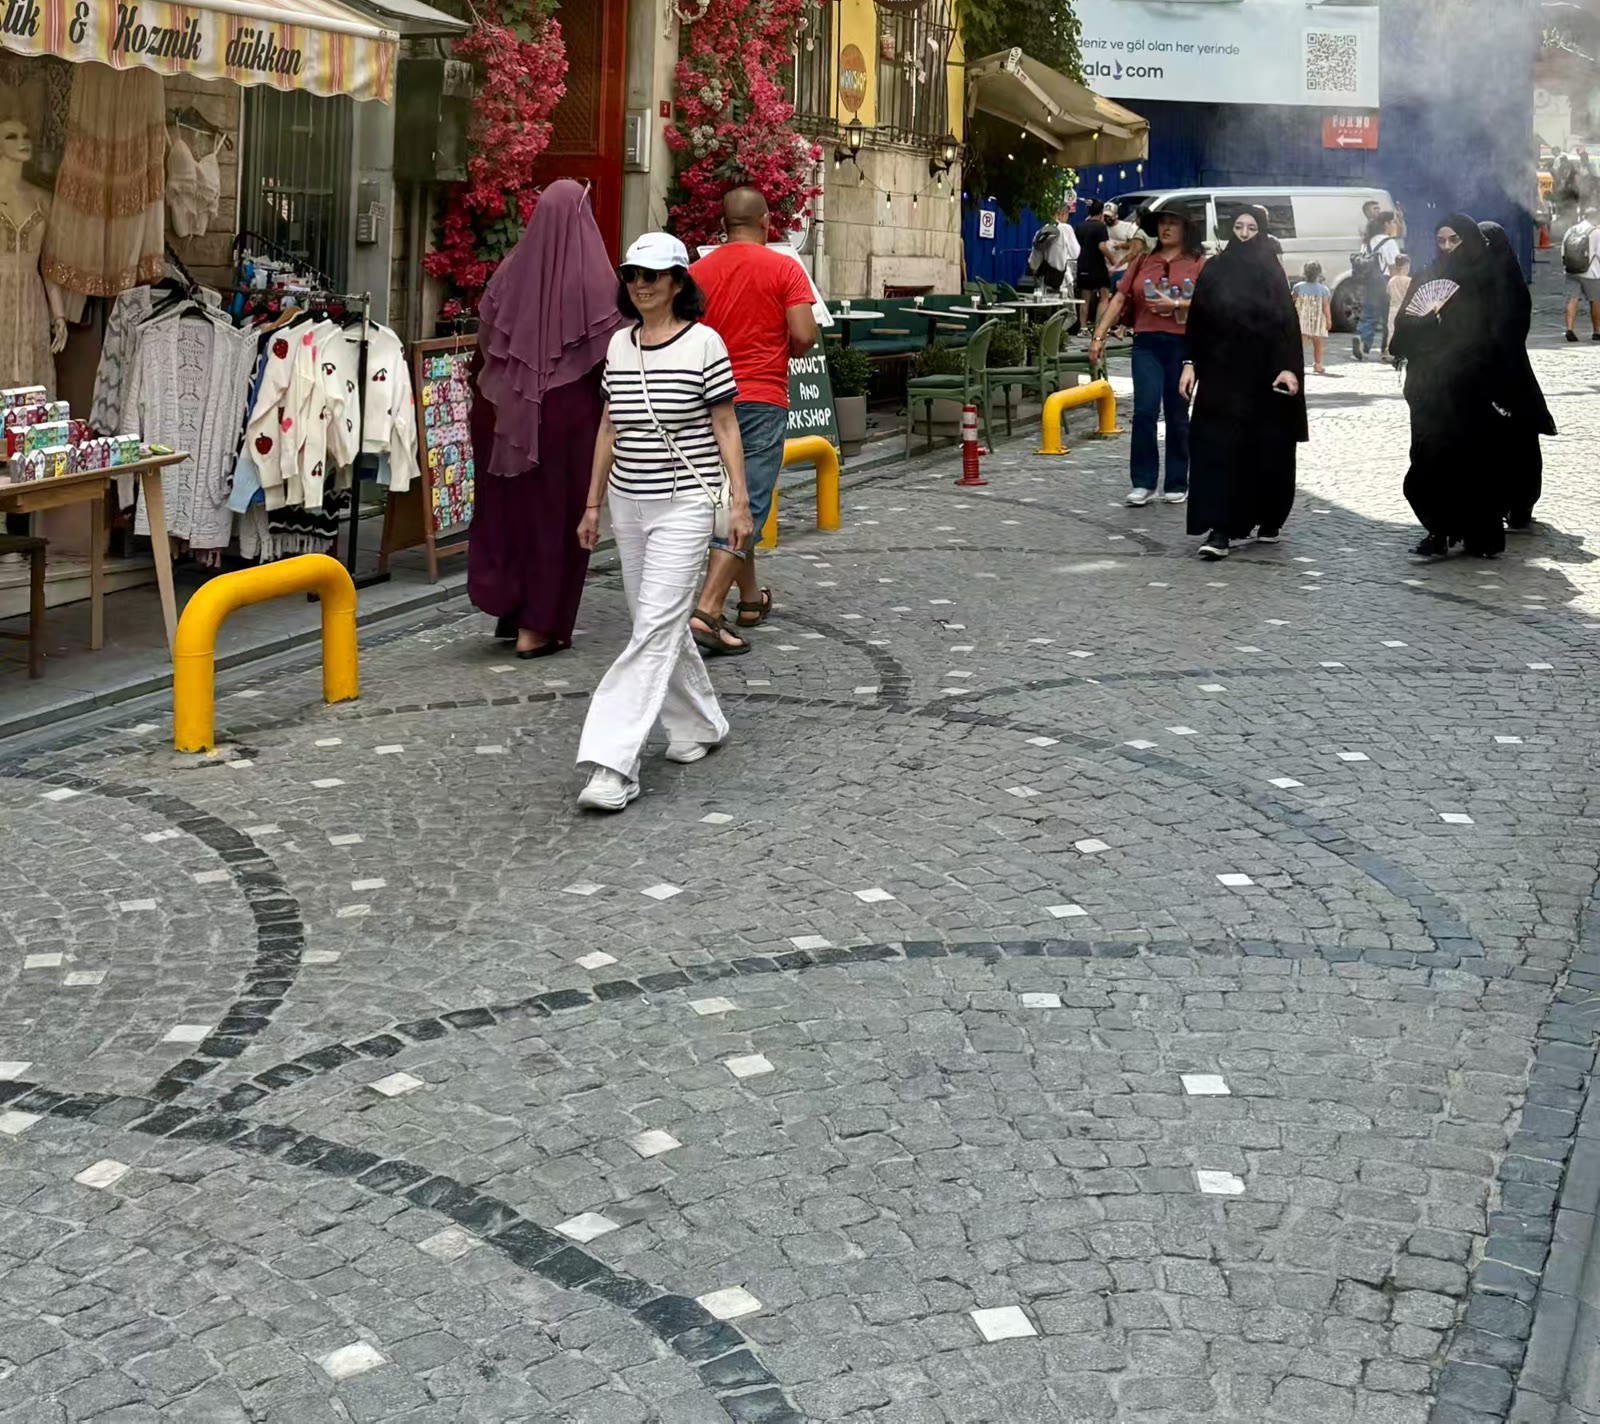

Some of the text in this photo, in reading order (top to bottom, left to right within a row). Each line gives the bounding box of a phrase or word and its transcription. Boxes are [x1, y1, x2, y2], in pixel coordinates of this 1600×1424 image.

[69, 1, 90, 44] &
[112, 3, 202, 61] Kozmik
[224, 26, 302, 77] dükkan
[1110, 41, 1124, 50] ve
[1126, 40, 1145, 53] göl
[1147, 40, 1174, 52] olan
[1175, 42, 1195, 53] her
[1197, 43, 1240, 56] yerinde
[787, 355, 826, 376] RODUCT
[799, 382, 820, 400] AND
[786, 407, 832, 430] RKSHOP
